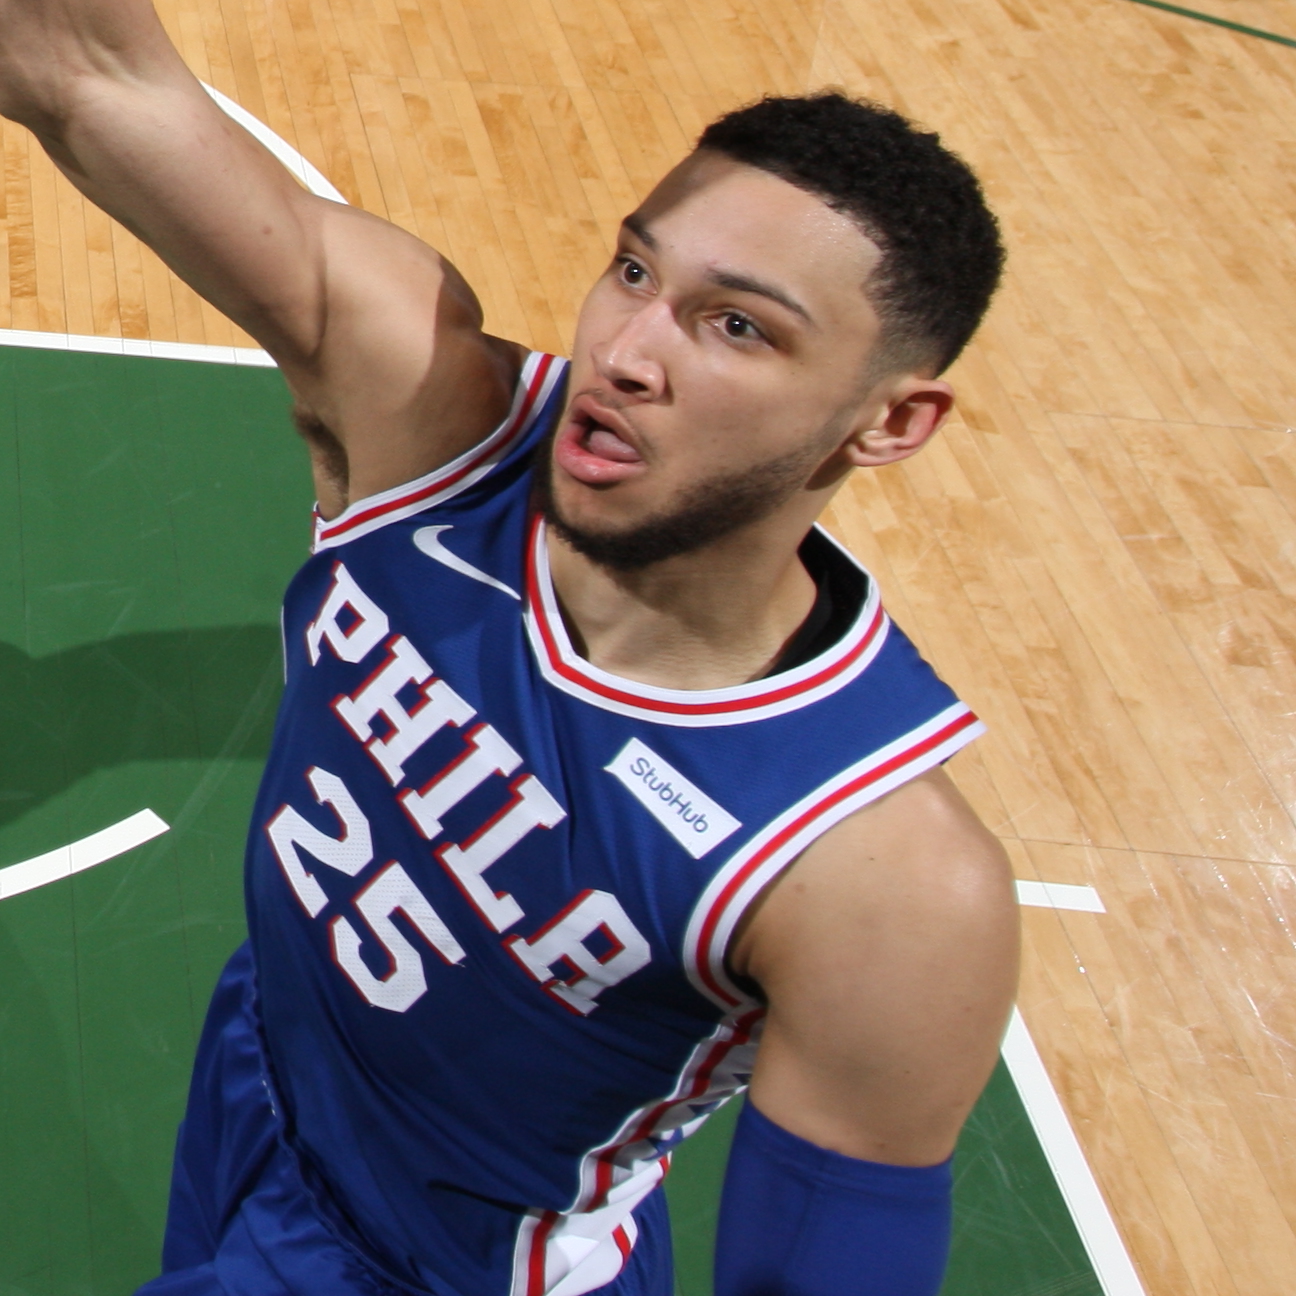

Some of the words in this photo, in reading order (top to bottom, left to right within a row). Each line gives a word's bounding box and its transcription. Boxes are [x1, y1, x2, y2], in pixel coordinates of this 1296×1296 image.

[266, 765, 468, 1015] 25
[306, 560, 653, 1017] PHILA
[629, 756, 709, 834] StubHub
